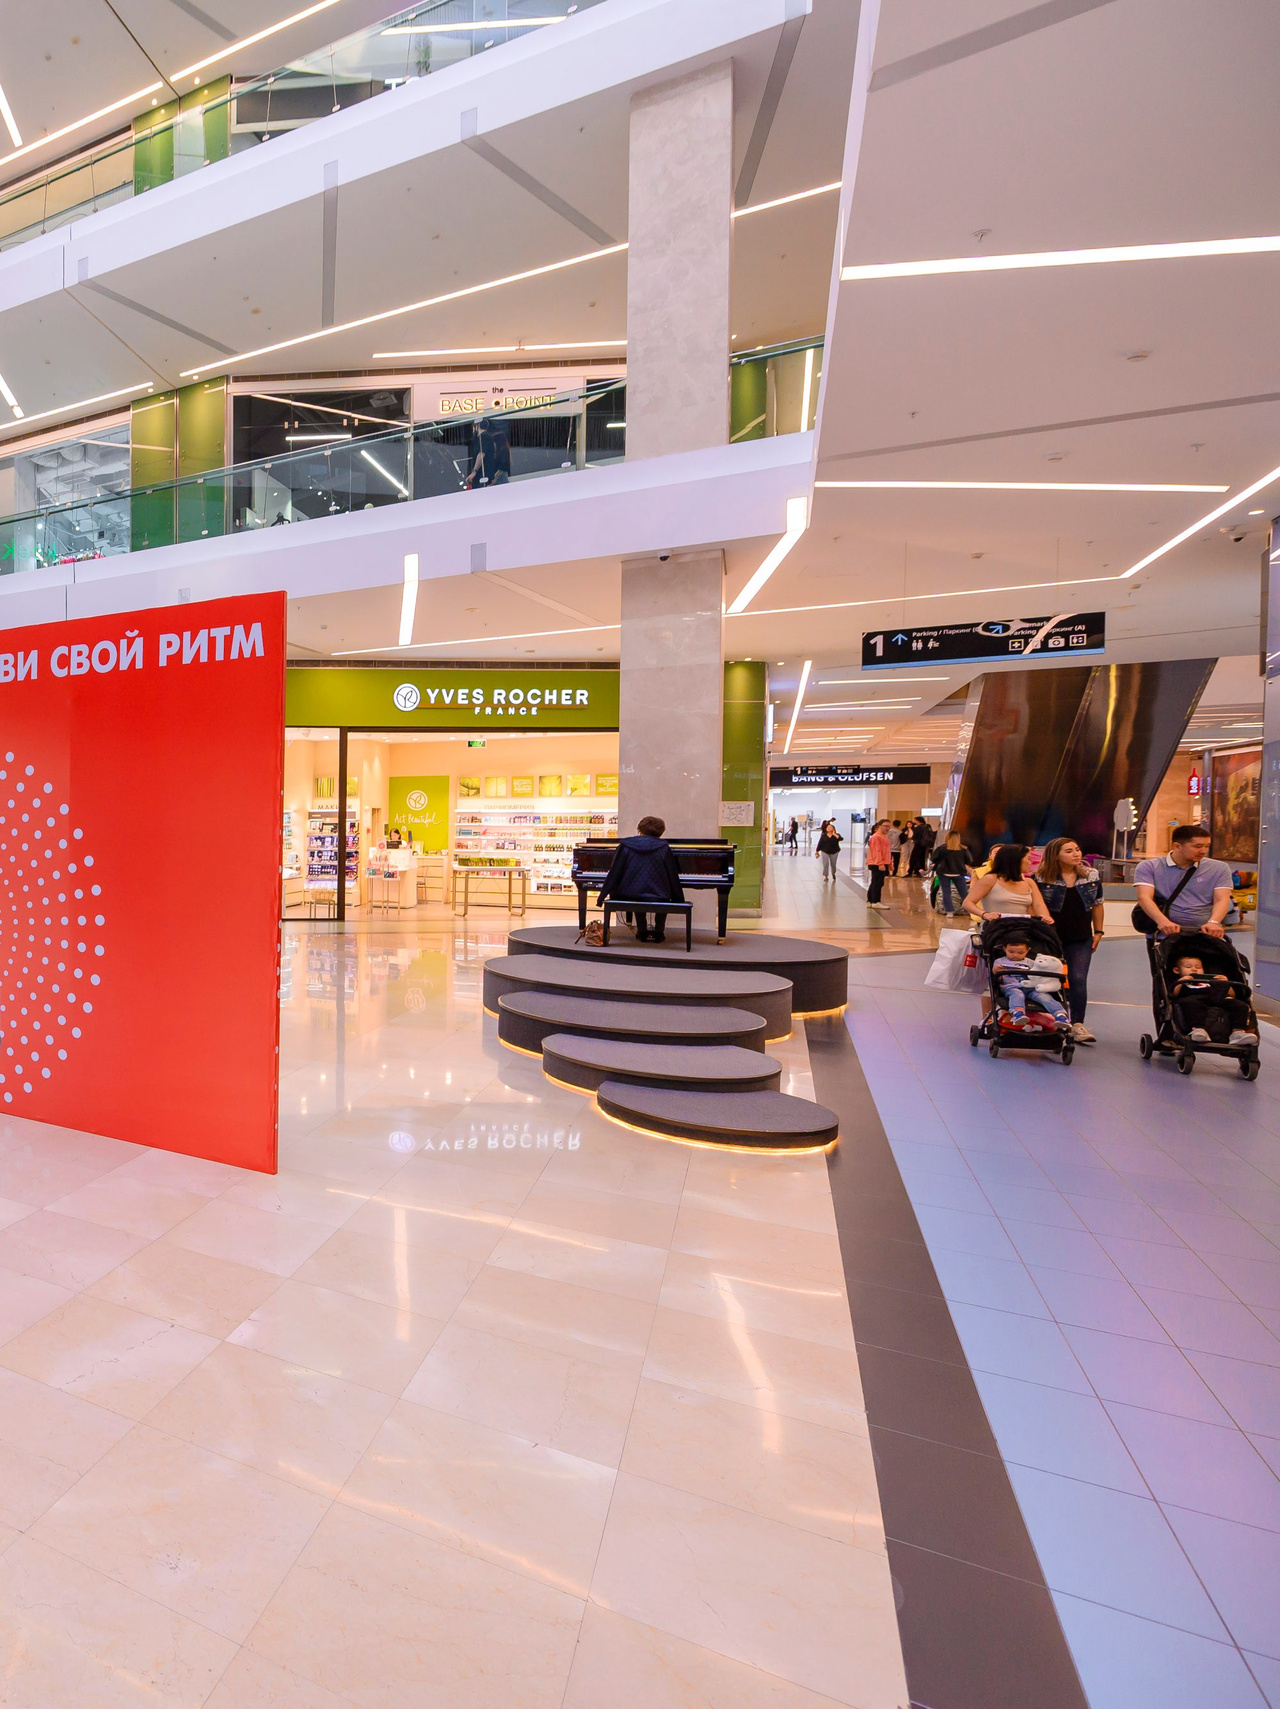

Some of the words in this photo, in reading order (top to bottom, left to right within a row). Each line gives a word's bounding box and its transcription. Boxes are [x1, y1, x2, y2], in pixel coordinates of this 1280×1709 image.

[492, 386, 504, 394] the
[441, 398, 485, 413] BASE
[504, 394, 555, 409] POINT
[943, 627, 971, 635] Паркинг
[50, 629, 144, 677] СВОЙ
[158, 622, 265, 667] РИТМ
[869, 634, 884, 657] 1
[426, 688, 485, 705] YVES
[492, 688, 589, 705] ROCHER
[474, 706, 538, 716] FRANCE
